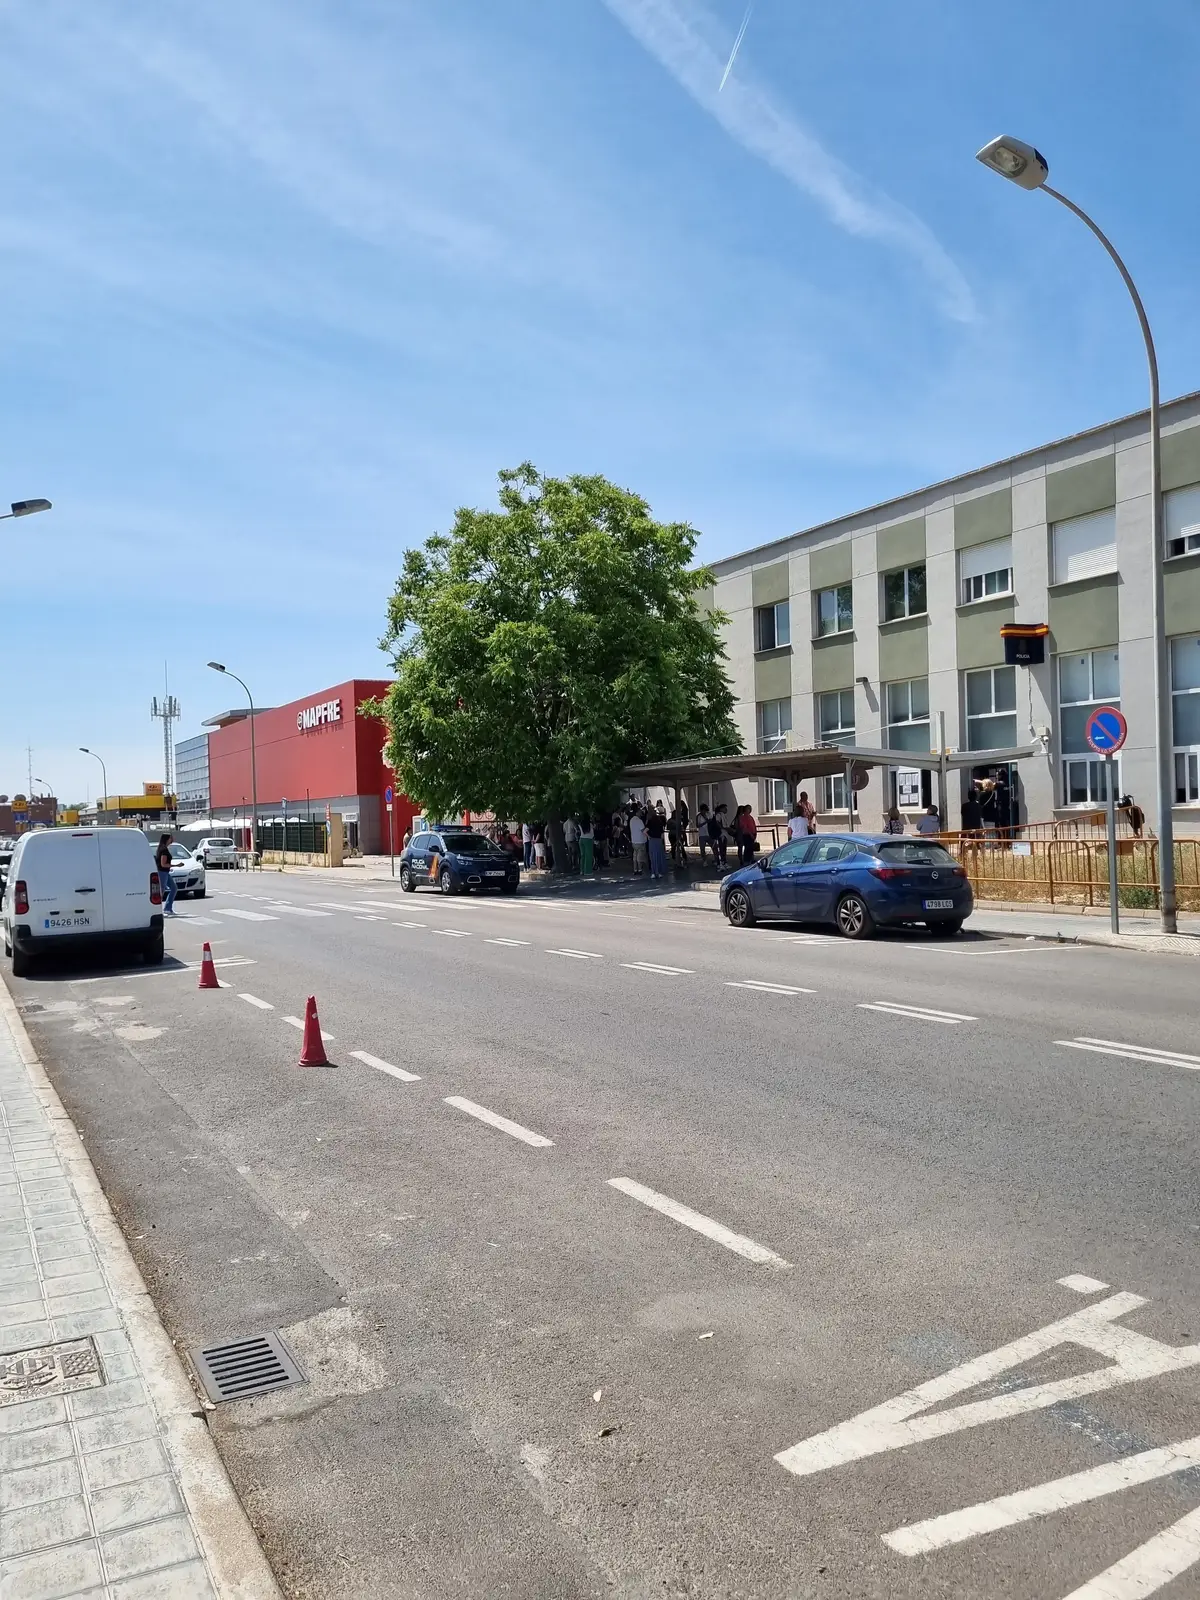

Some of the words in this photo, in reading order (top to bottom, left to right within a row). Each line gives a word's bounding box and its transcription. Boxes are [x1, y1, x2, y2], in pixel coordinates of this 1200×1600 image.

[302, 699, 340, 728] MAPFRE
[50, 918, 72, 927] 9426
[74, 917, 90, 926] HSN
